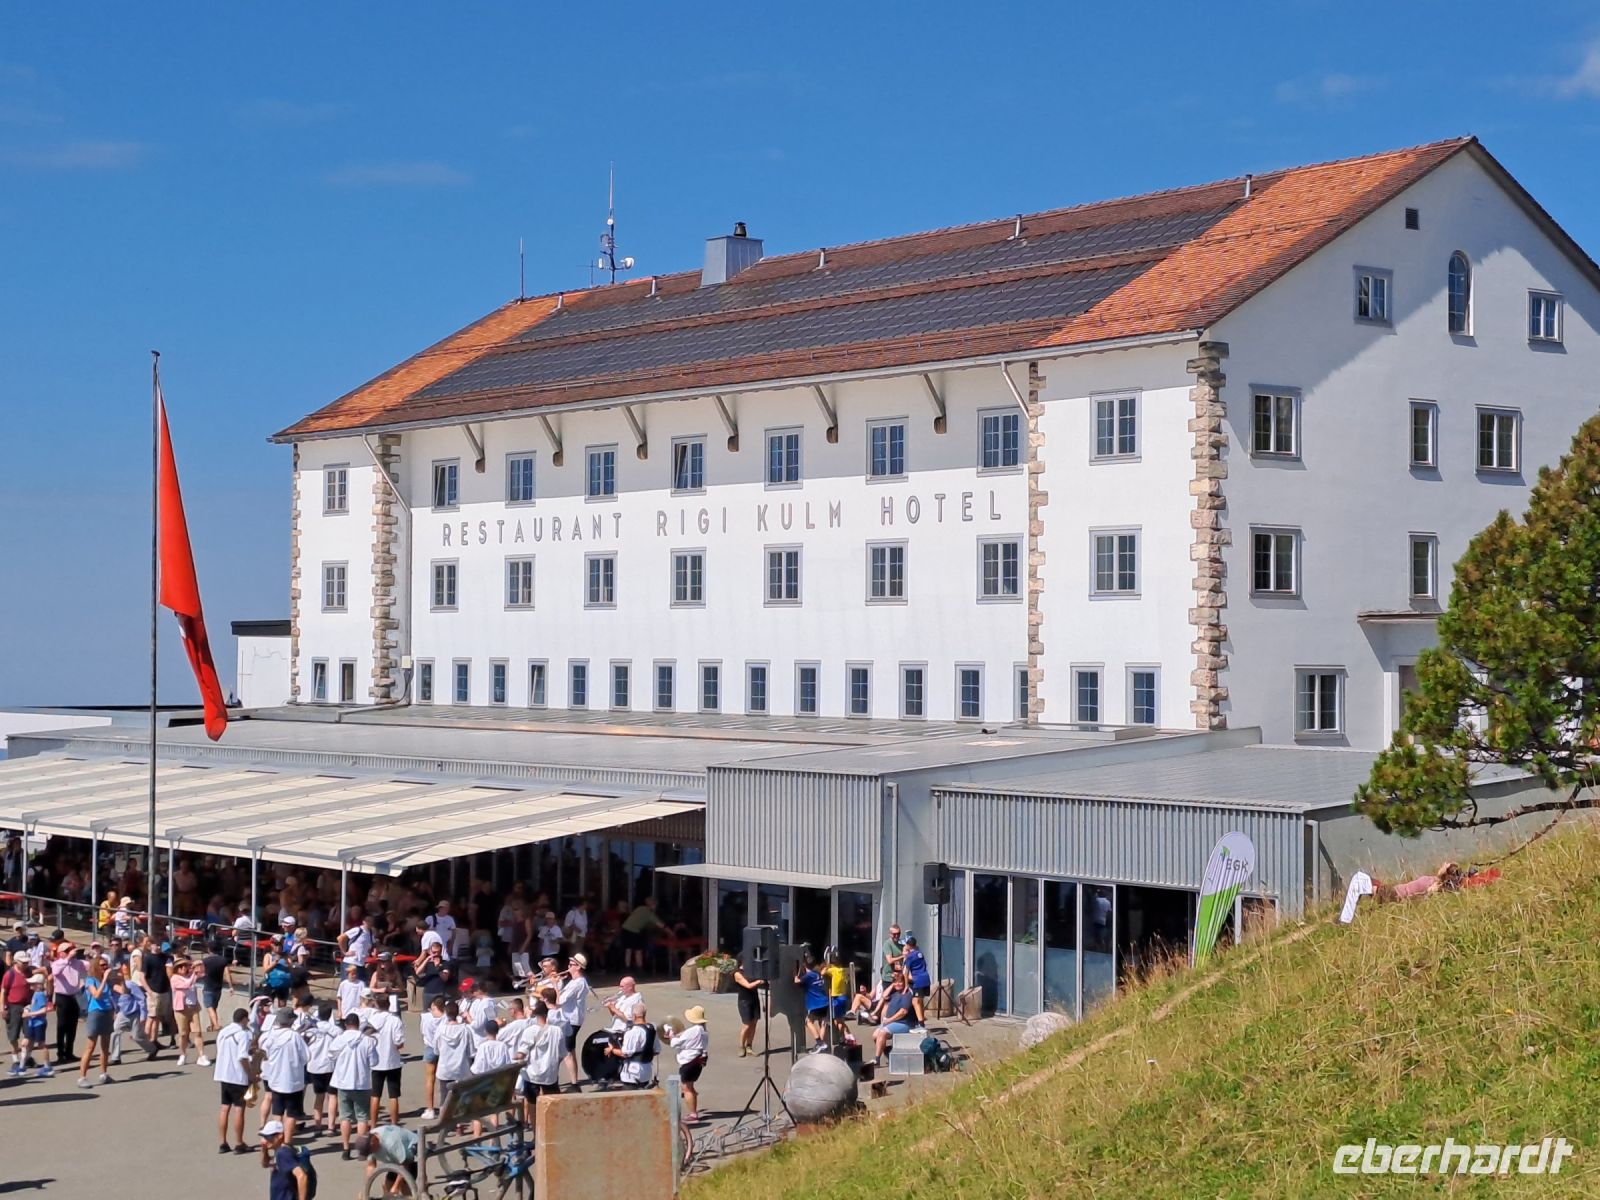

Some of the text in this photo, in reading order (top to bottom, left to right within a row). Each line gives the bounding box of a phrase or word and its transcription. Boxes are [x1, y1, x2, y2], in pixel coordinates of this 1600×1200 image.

[442, 491, 1001, 546] RESTAURANT RIGI KULM HOTEL
[1226, 858, 1248, 872] EGK
